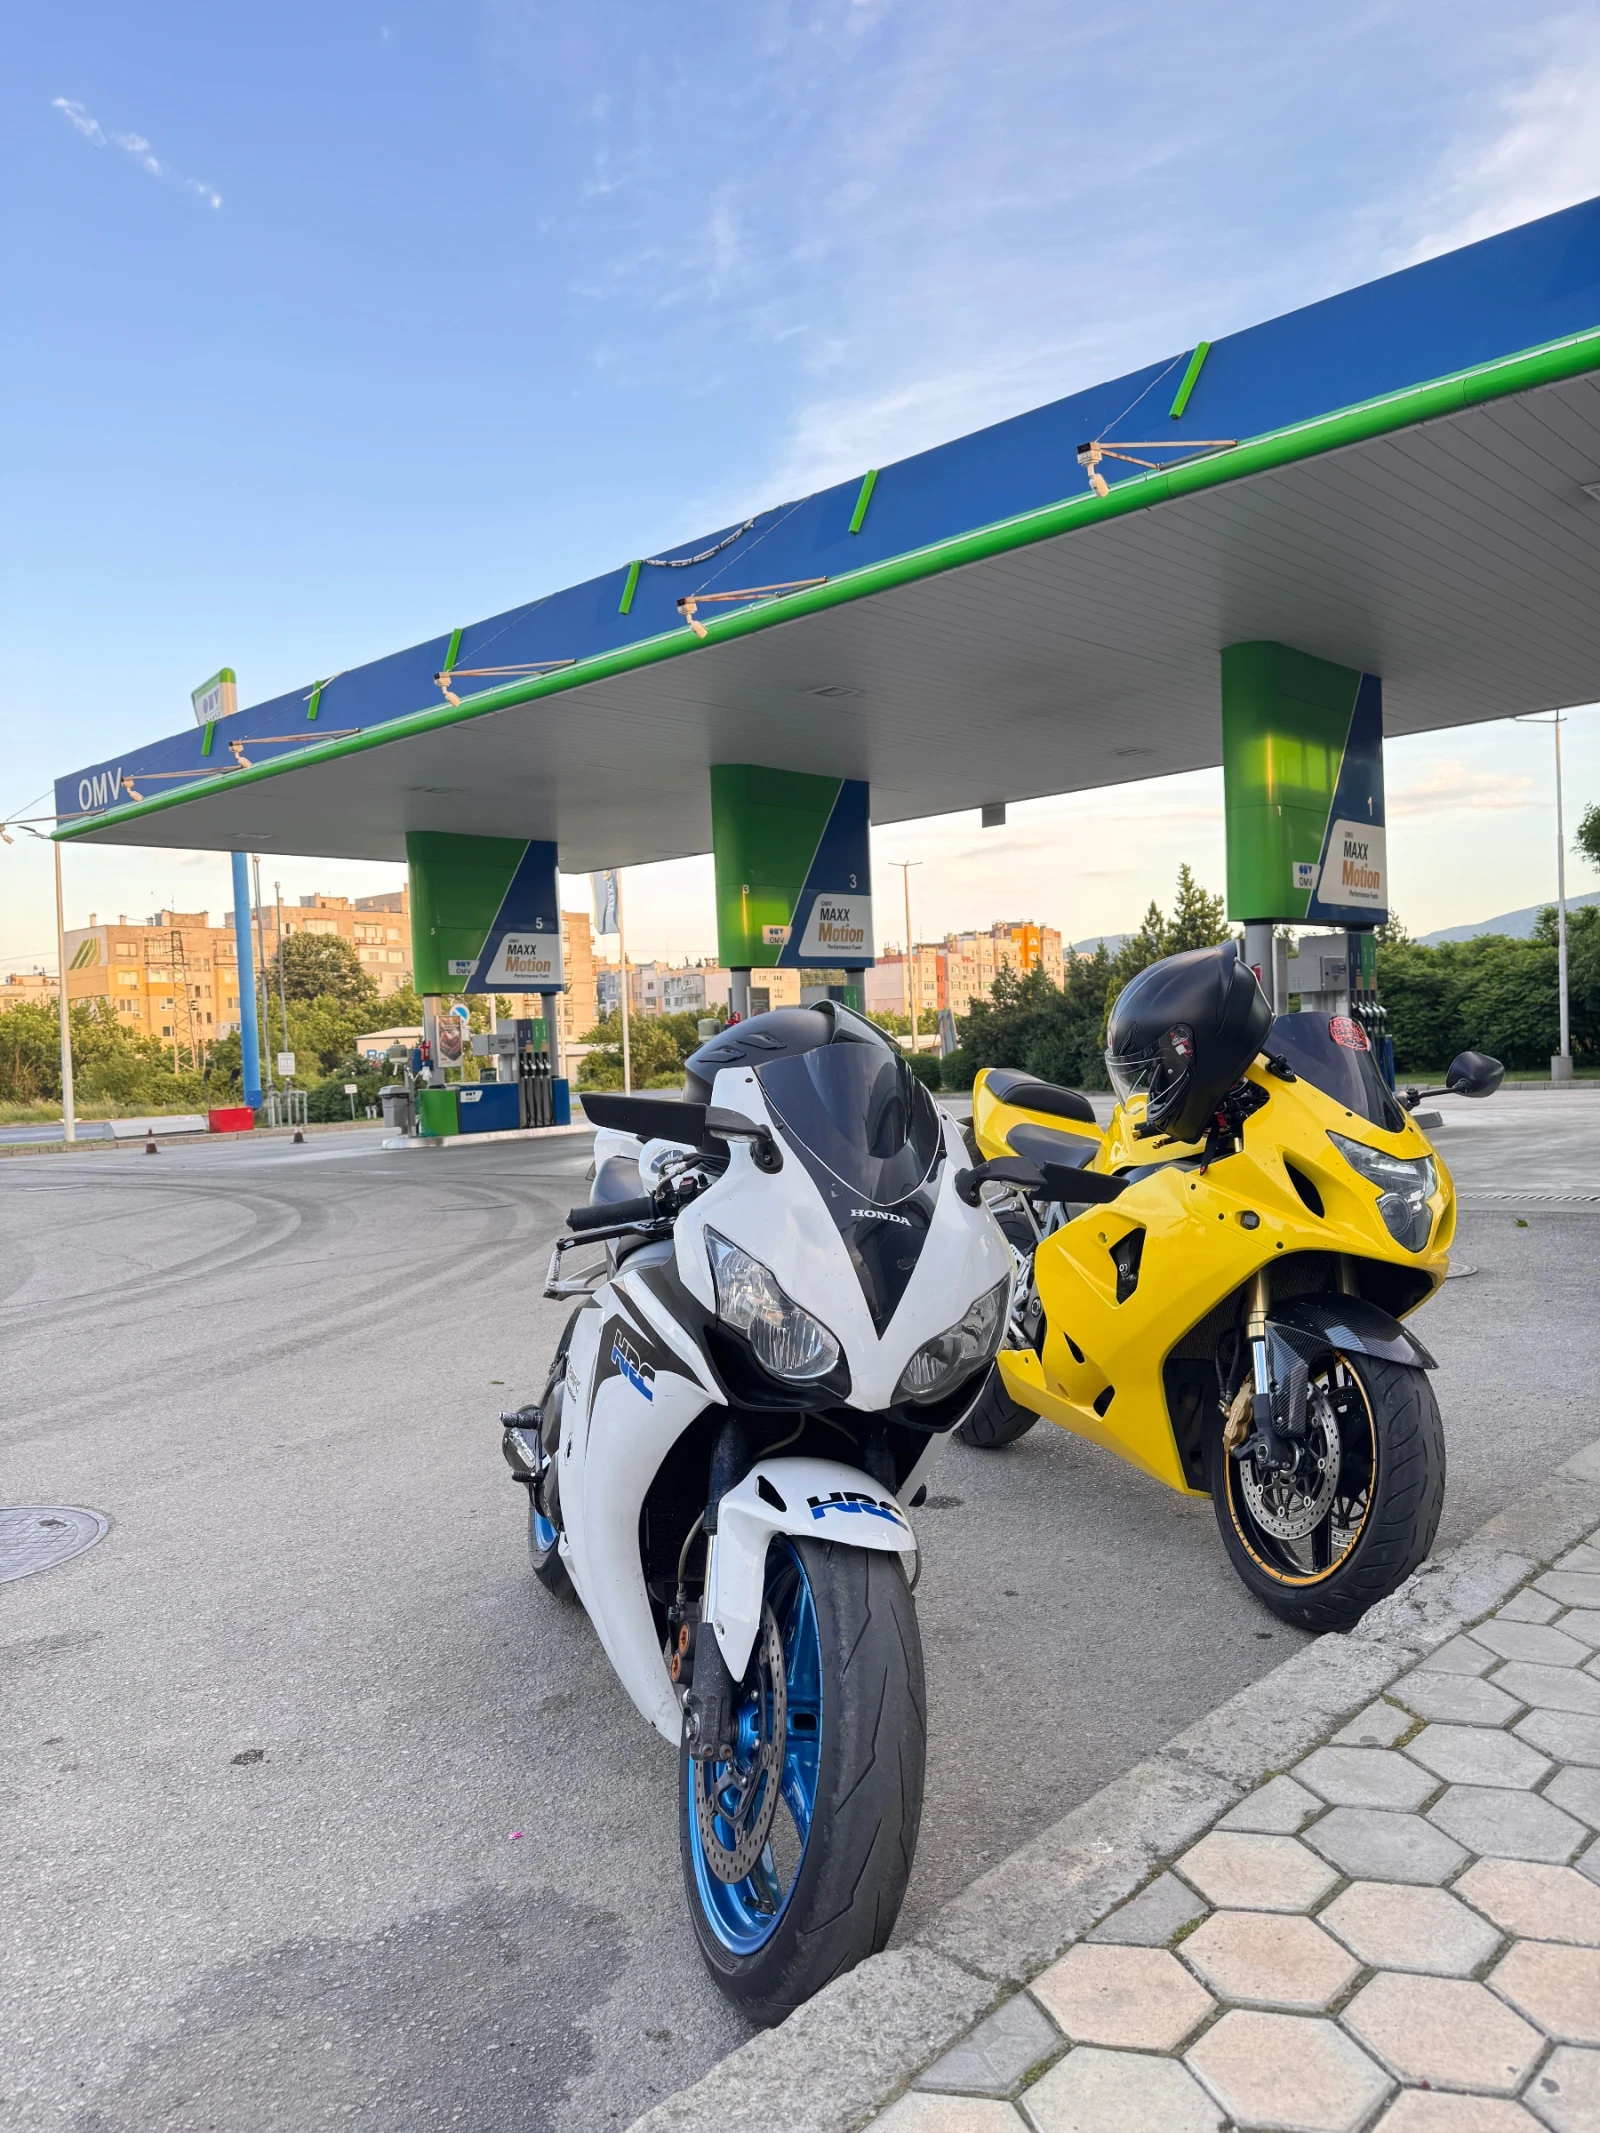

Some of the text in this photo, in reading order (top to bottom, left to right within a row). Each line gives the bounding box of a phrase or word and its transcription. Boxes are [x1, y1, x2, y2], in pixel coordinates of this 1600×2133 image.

[79, 766, 122, 811] OMV
[1367, 796, 1374, 816] 1
[1343, 840, 1369, 861] MAXX
[849, 873, 857, 889] 3
[1299, 876, 1313, 888] OMV
[1342, 859, 1380, 890] Motion
[743, 884, 750, 894] 3
[535, 917, 544, 929] 5
[819, 907, 851, 922] MAXX
[430, 927, 436, 936] 5
[769, 936, 785, 944] OMV
[817, 922, 865, 943] Motion
[507, 944, 537, 956] MAXX
[505, 956, 552, 973] Motion
[850, 1208, 912, 1227] HONDA
[611, 1328, 656, 1403] HRC
[806, 1491, 910, 1533] HRC
